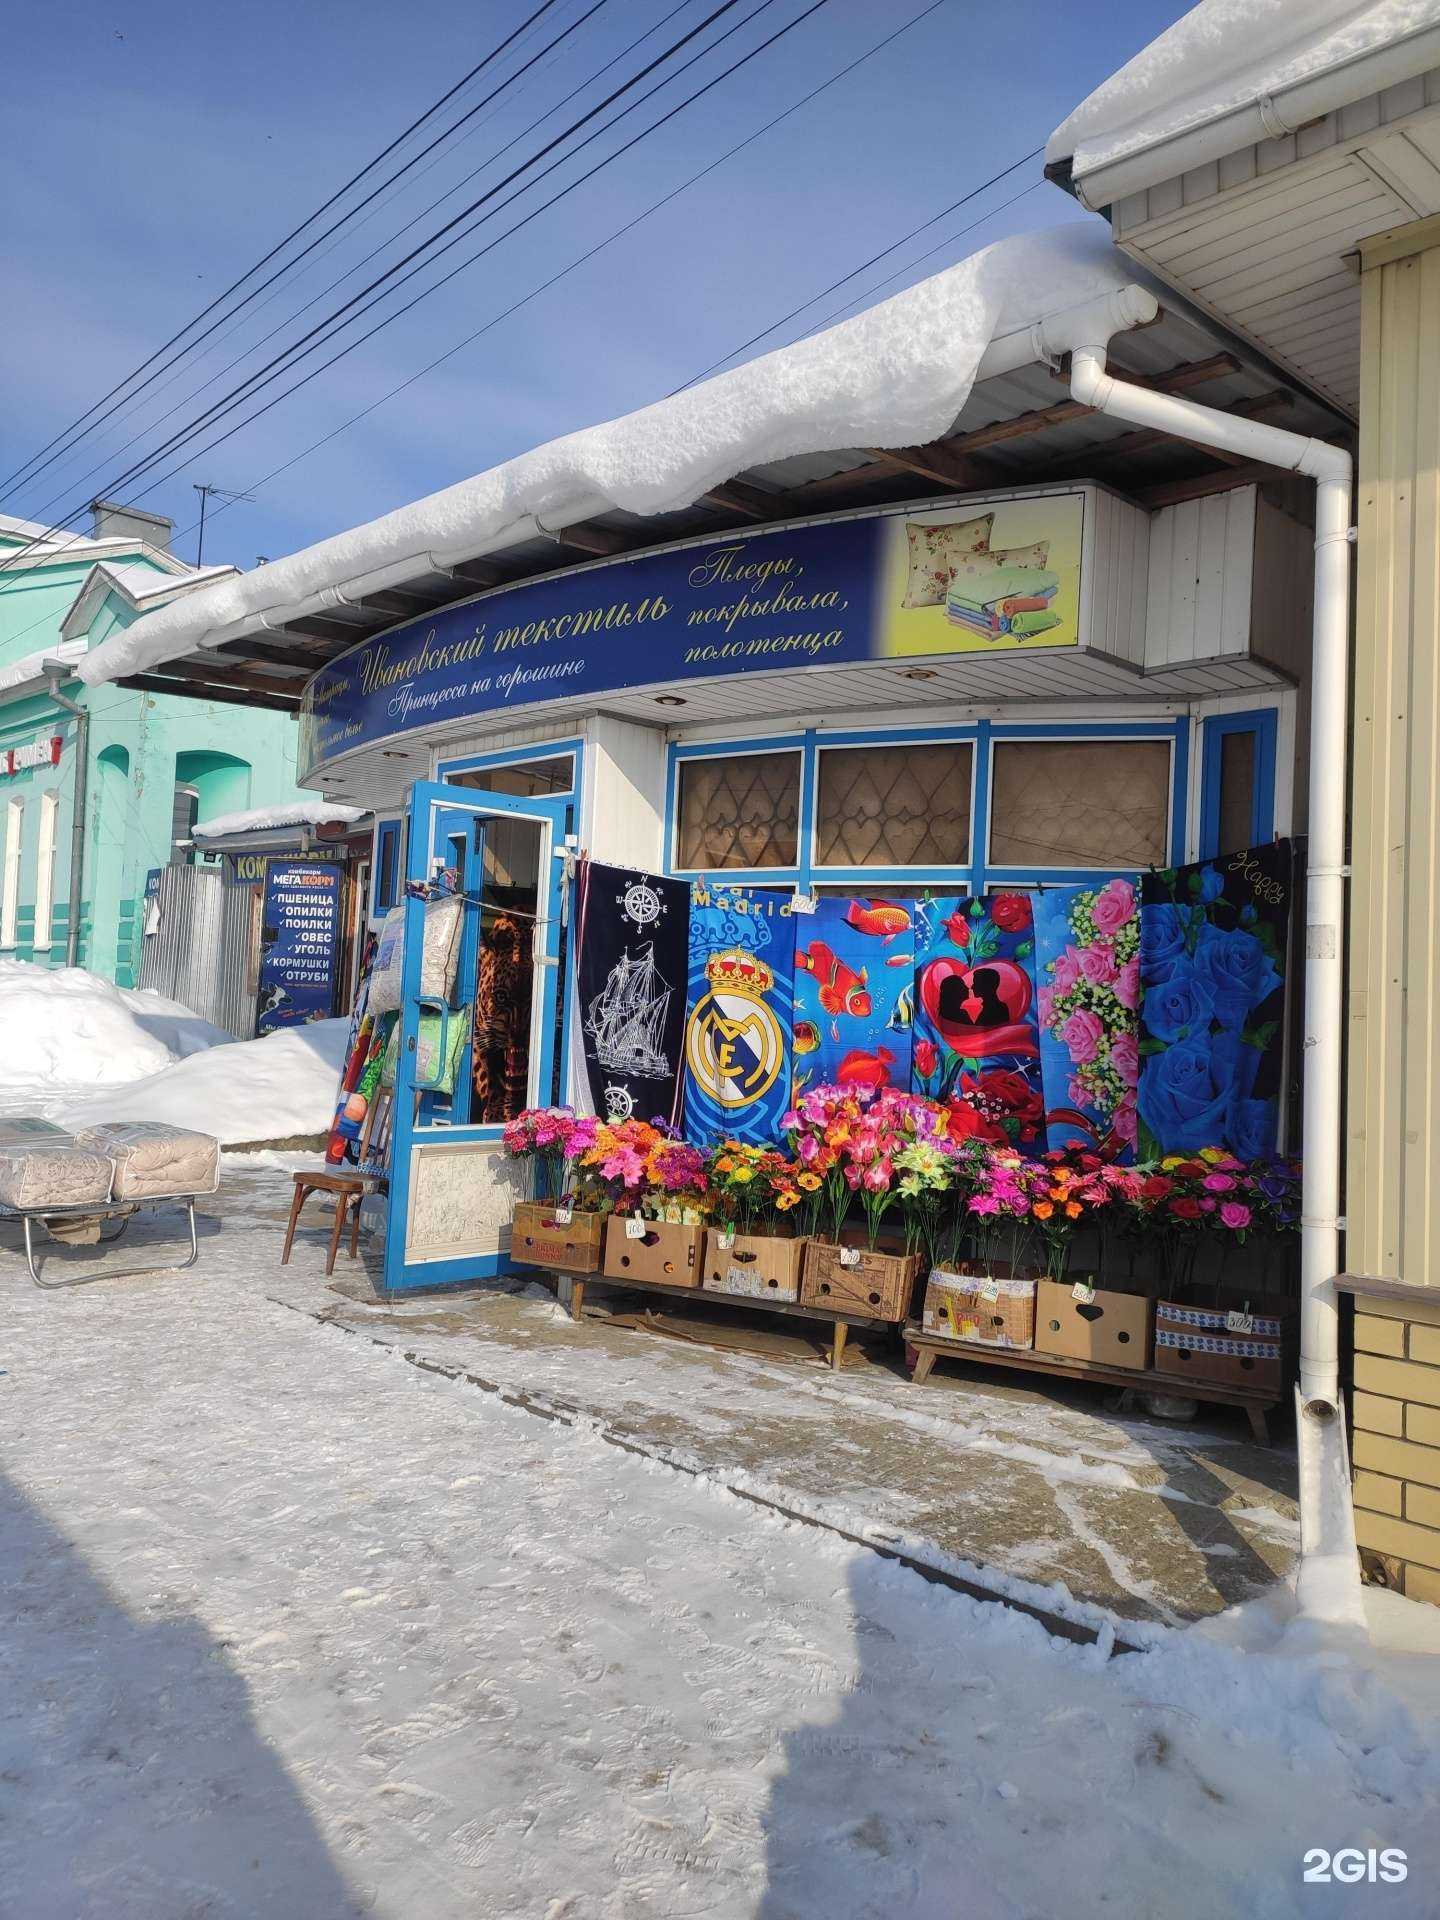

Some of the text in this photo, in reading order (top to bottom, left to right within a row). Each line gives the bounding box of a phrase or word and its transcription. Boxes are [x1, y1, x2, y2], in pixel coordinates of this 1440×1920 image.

[687, 544, 804, 594] Пледы,
[687, 580, 849, 633] покрывала,
[358, 595, 674, 697] Ивановский текстиль
[683, 629, 845, 663] полотенца
[387, 681, 469, 723] Принцесса
[470, 678, 492, 696] на
[495, 658, 586, 698] горошине
[1228, 850, 1285, 905] Happy
[277, 893, 334, 906] ПШЕНИЦА
[693, 889, 792, 918] Madrid
[285, 906, 333, 917] ОПИЛКИ
[285, 919, 332, 930] ПОИЛКИ
[301, 932, 332, 943] ОВЕС
[294, 944, 331, 955] УГОЛЬ
[273, 957, 329, 969] КОРМУШКИ
[286, 971, 329, 982] ОТРУБИ
